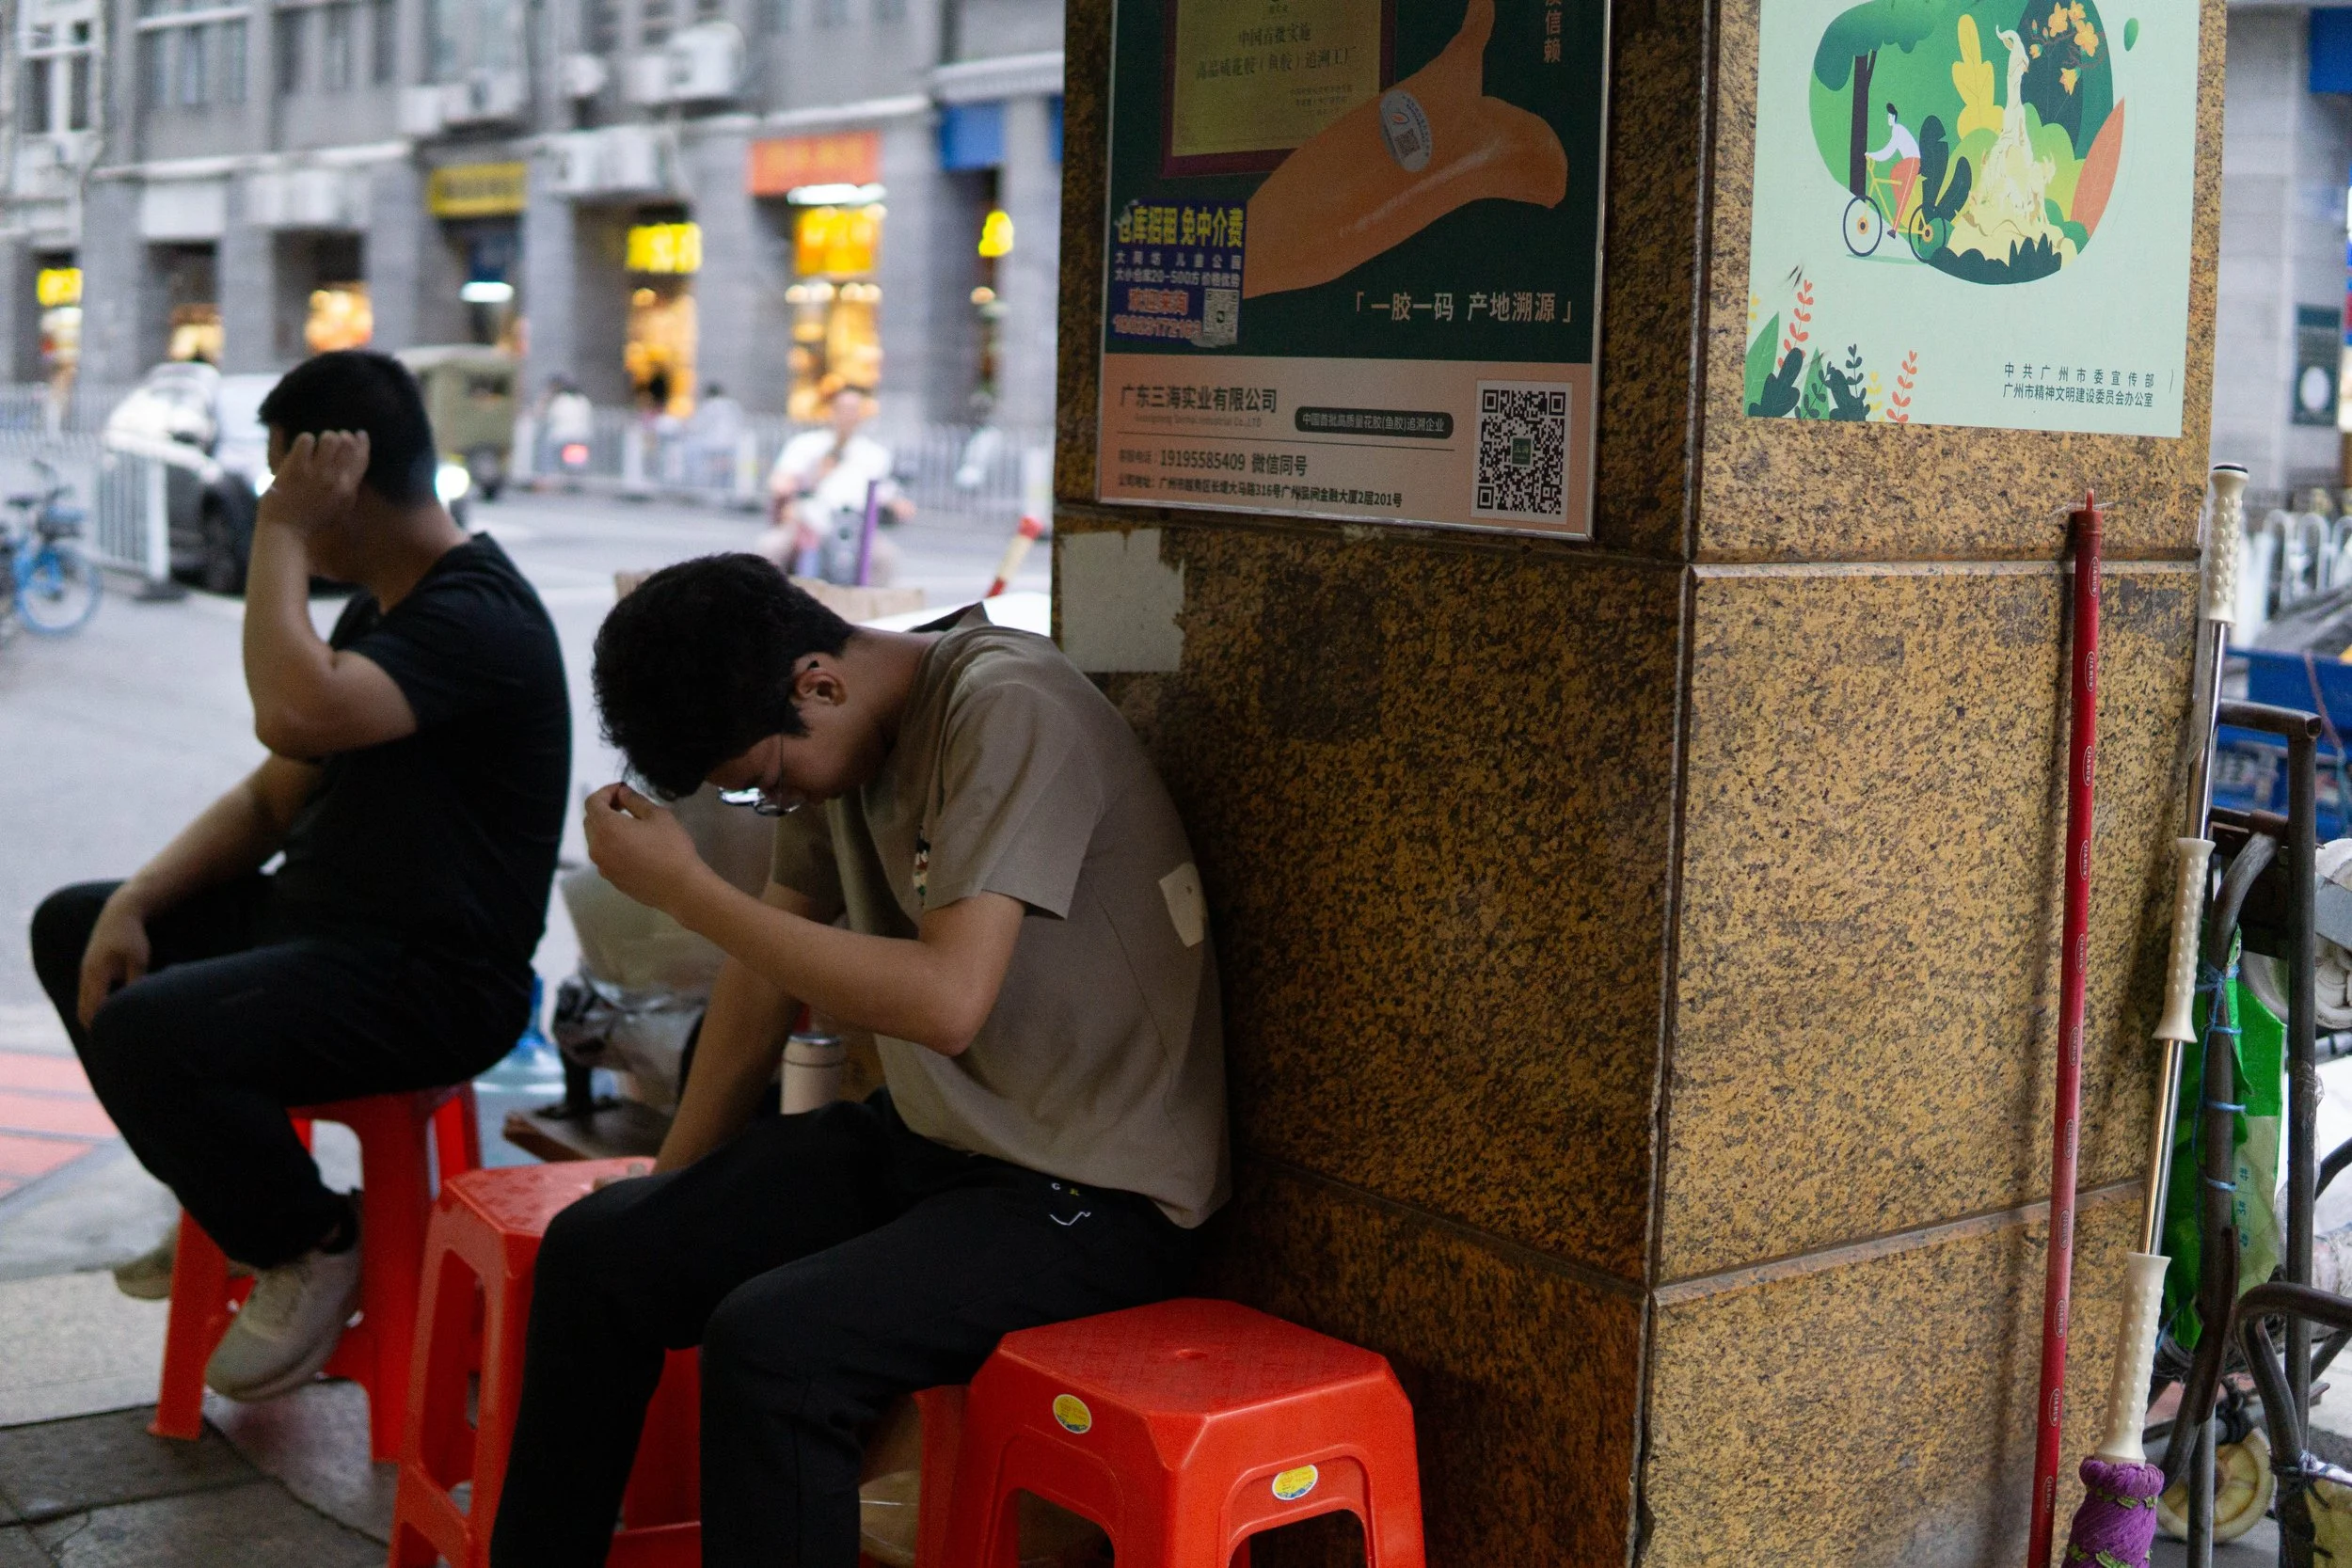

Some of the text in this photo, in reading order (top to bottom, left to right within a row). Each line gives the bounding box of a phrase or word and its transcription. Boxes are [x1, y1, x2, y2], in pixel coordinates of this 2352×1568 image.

[1544, 0, 1563, 64] 信赖
[2005, 361, 2154, 388] 中共广州市委宣传部
[1120, 384, 1278, 413] 广东三海实业有限公司
[2003, 383, 2153, 407] 广州市精神文明建设委员会办公室
[1160, 449, 1246, 470] 19195585409
[1251, 452, 1308, 476] 微信同号
